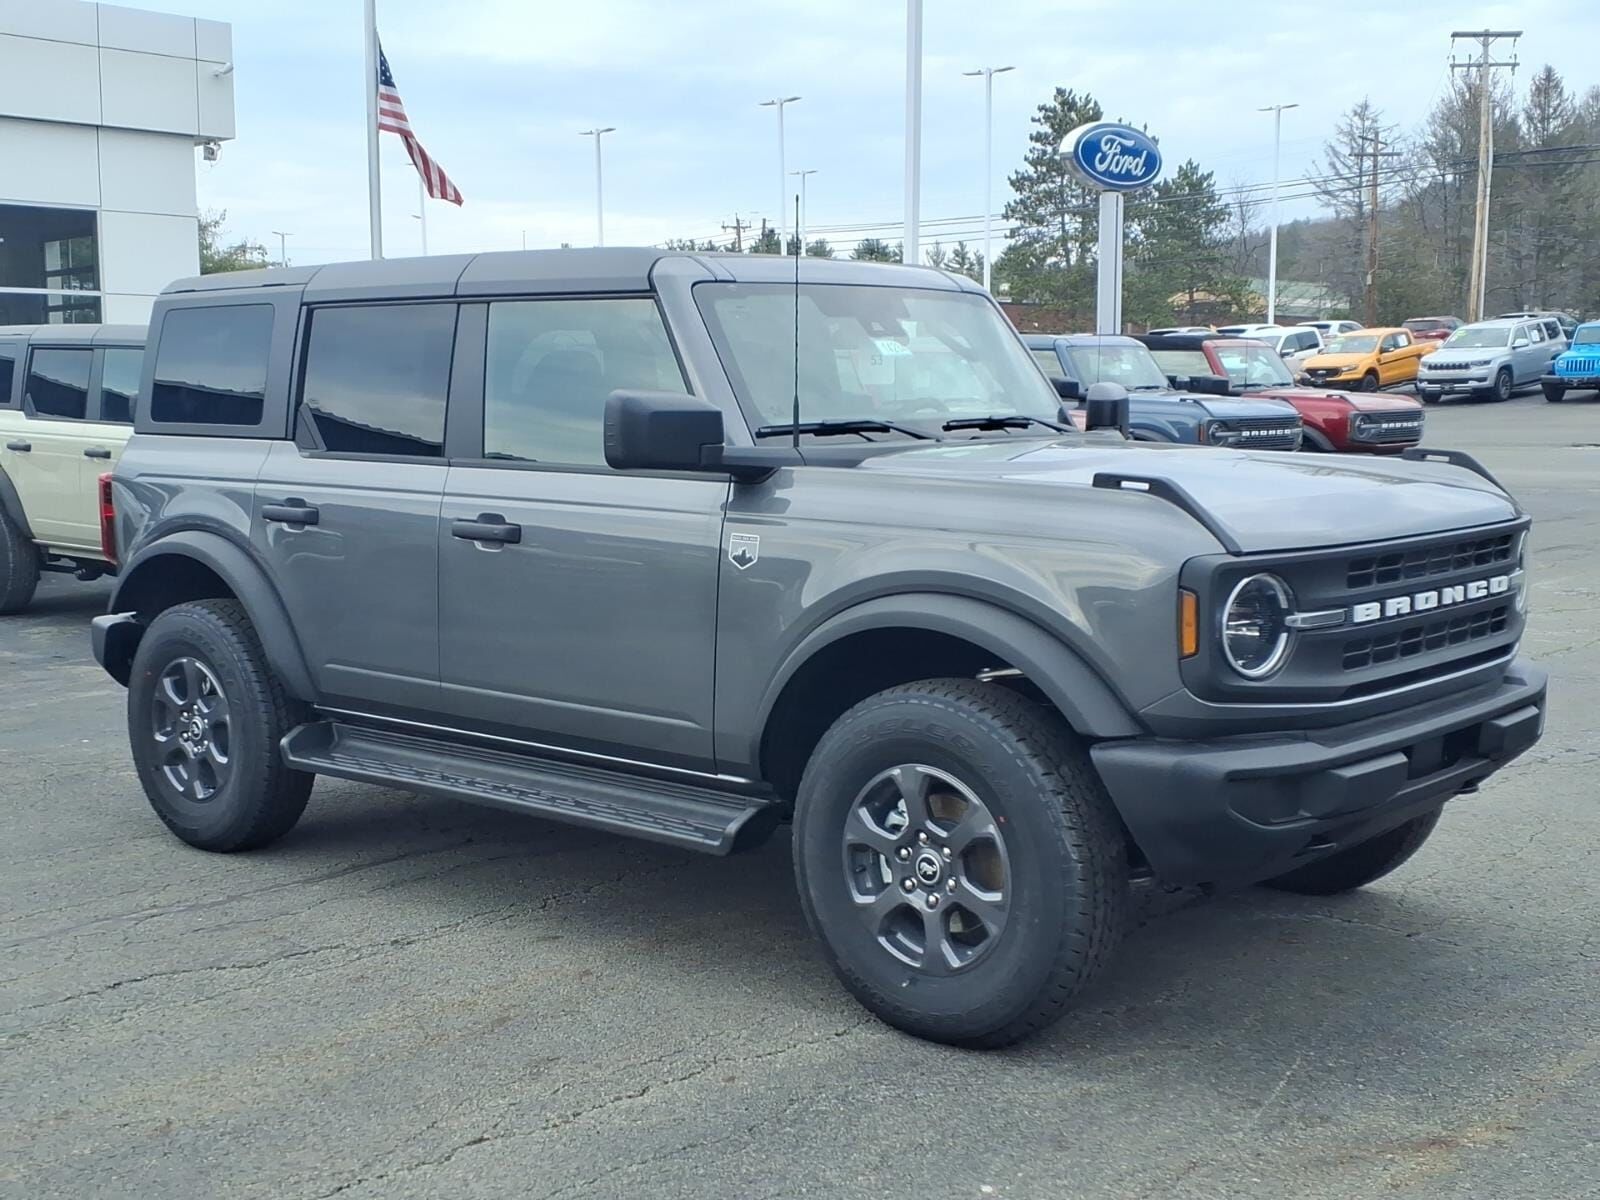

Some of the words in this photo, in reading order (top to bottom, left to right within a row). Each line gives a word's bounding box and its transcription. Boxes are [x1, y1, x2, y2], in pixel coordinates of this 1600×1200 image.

[1095, 134, 1146, 176] Ford
[1241, 428, 1291, 437] BRONCO
[1353, 575, 1509, 623] BRONCO
